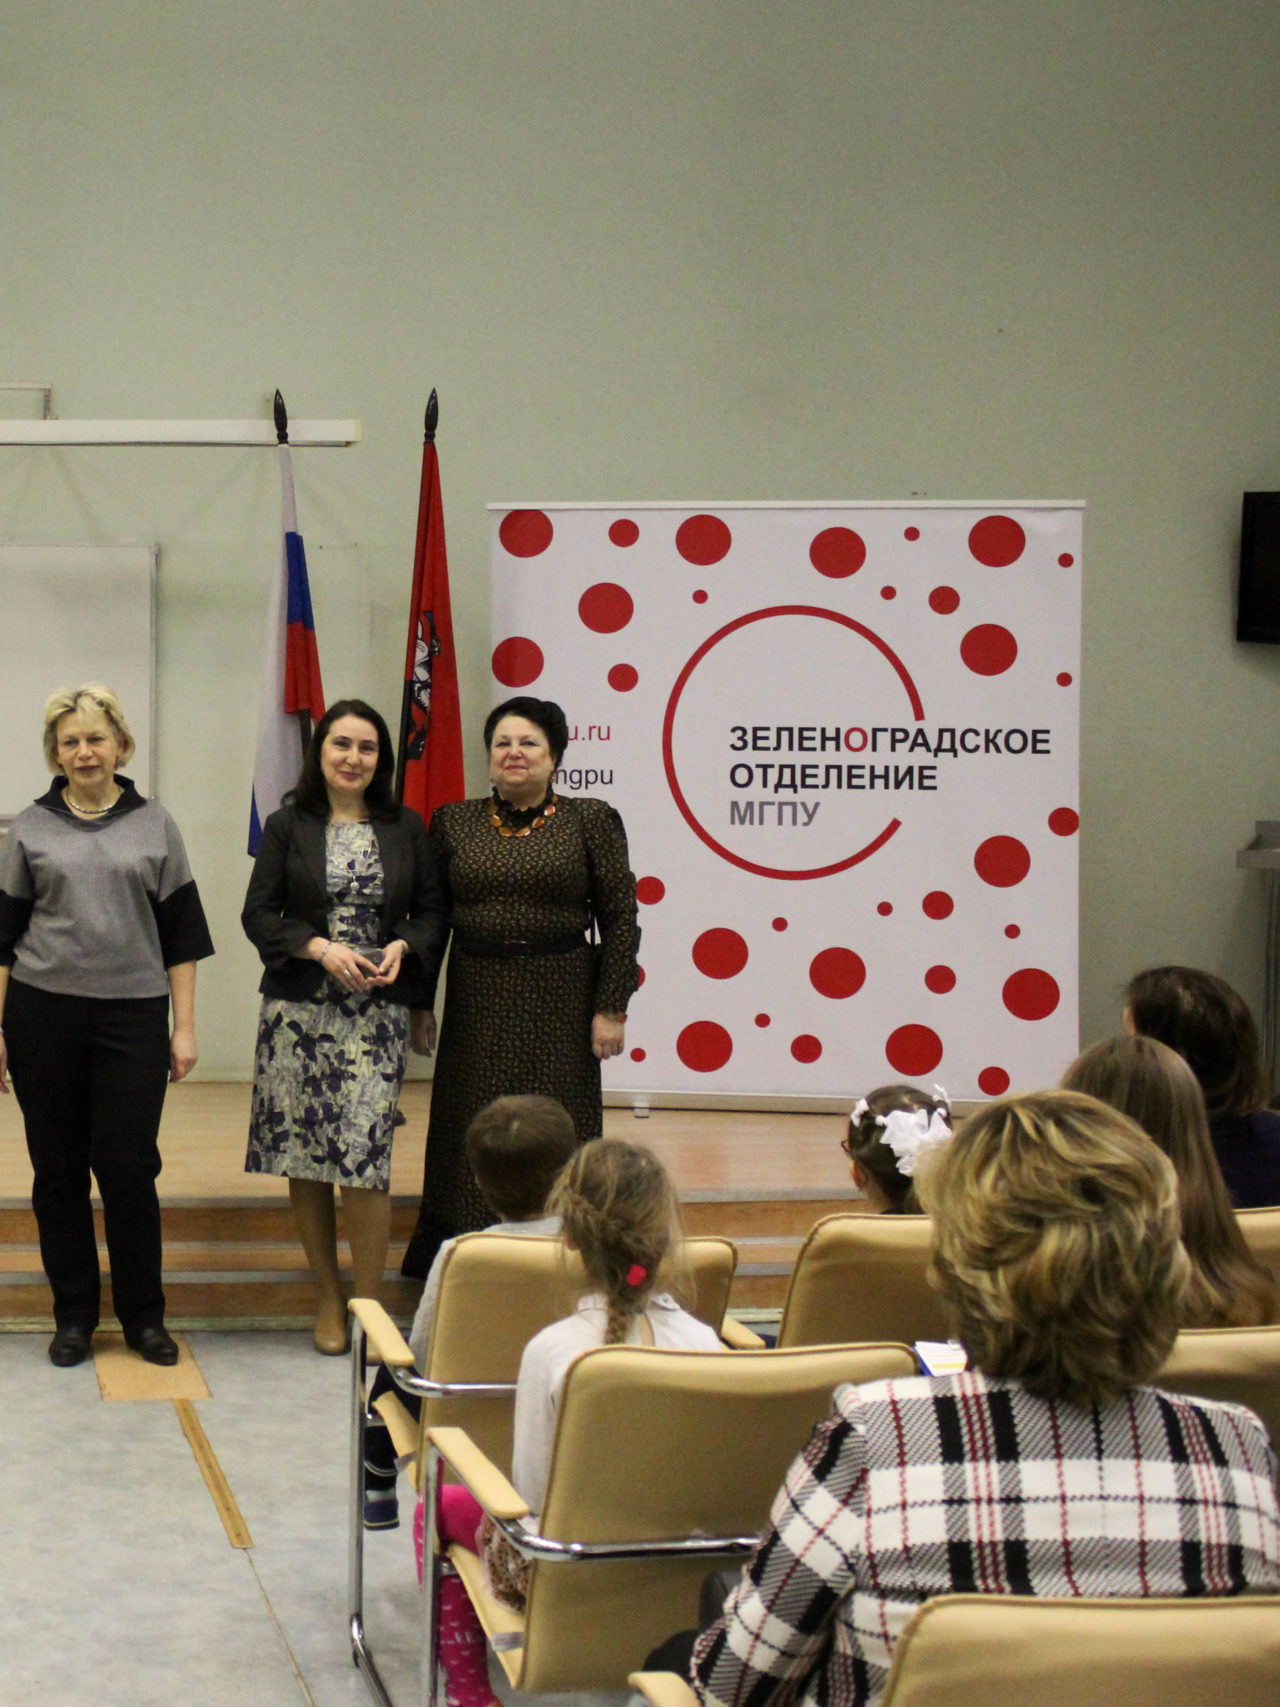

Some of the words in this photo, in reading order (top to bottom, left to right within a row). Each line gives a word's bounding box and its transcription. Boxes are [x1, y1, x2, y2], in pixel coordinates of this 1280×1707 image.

[729, 726, 1051, 758] ЗЕЛЕНОГРАДСКОЕ
[729, 763, 938, 794] ОТДЕЛЕНИЕ
[729, 800, 821, 826] МГПУ
